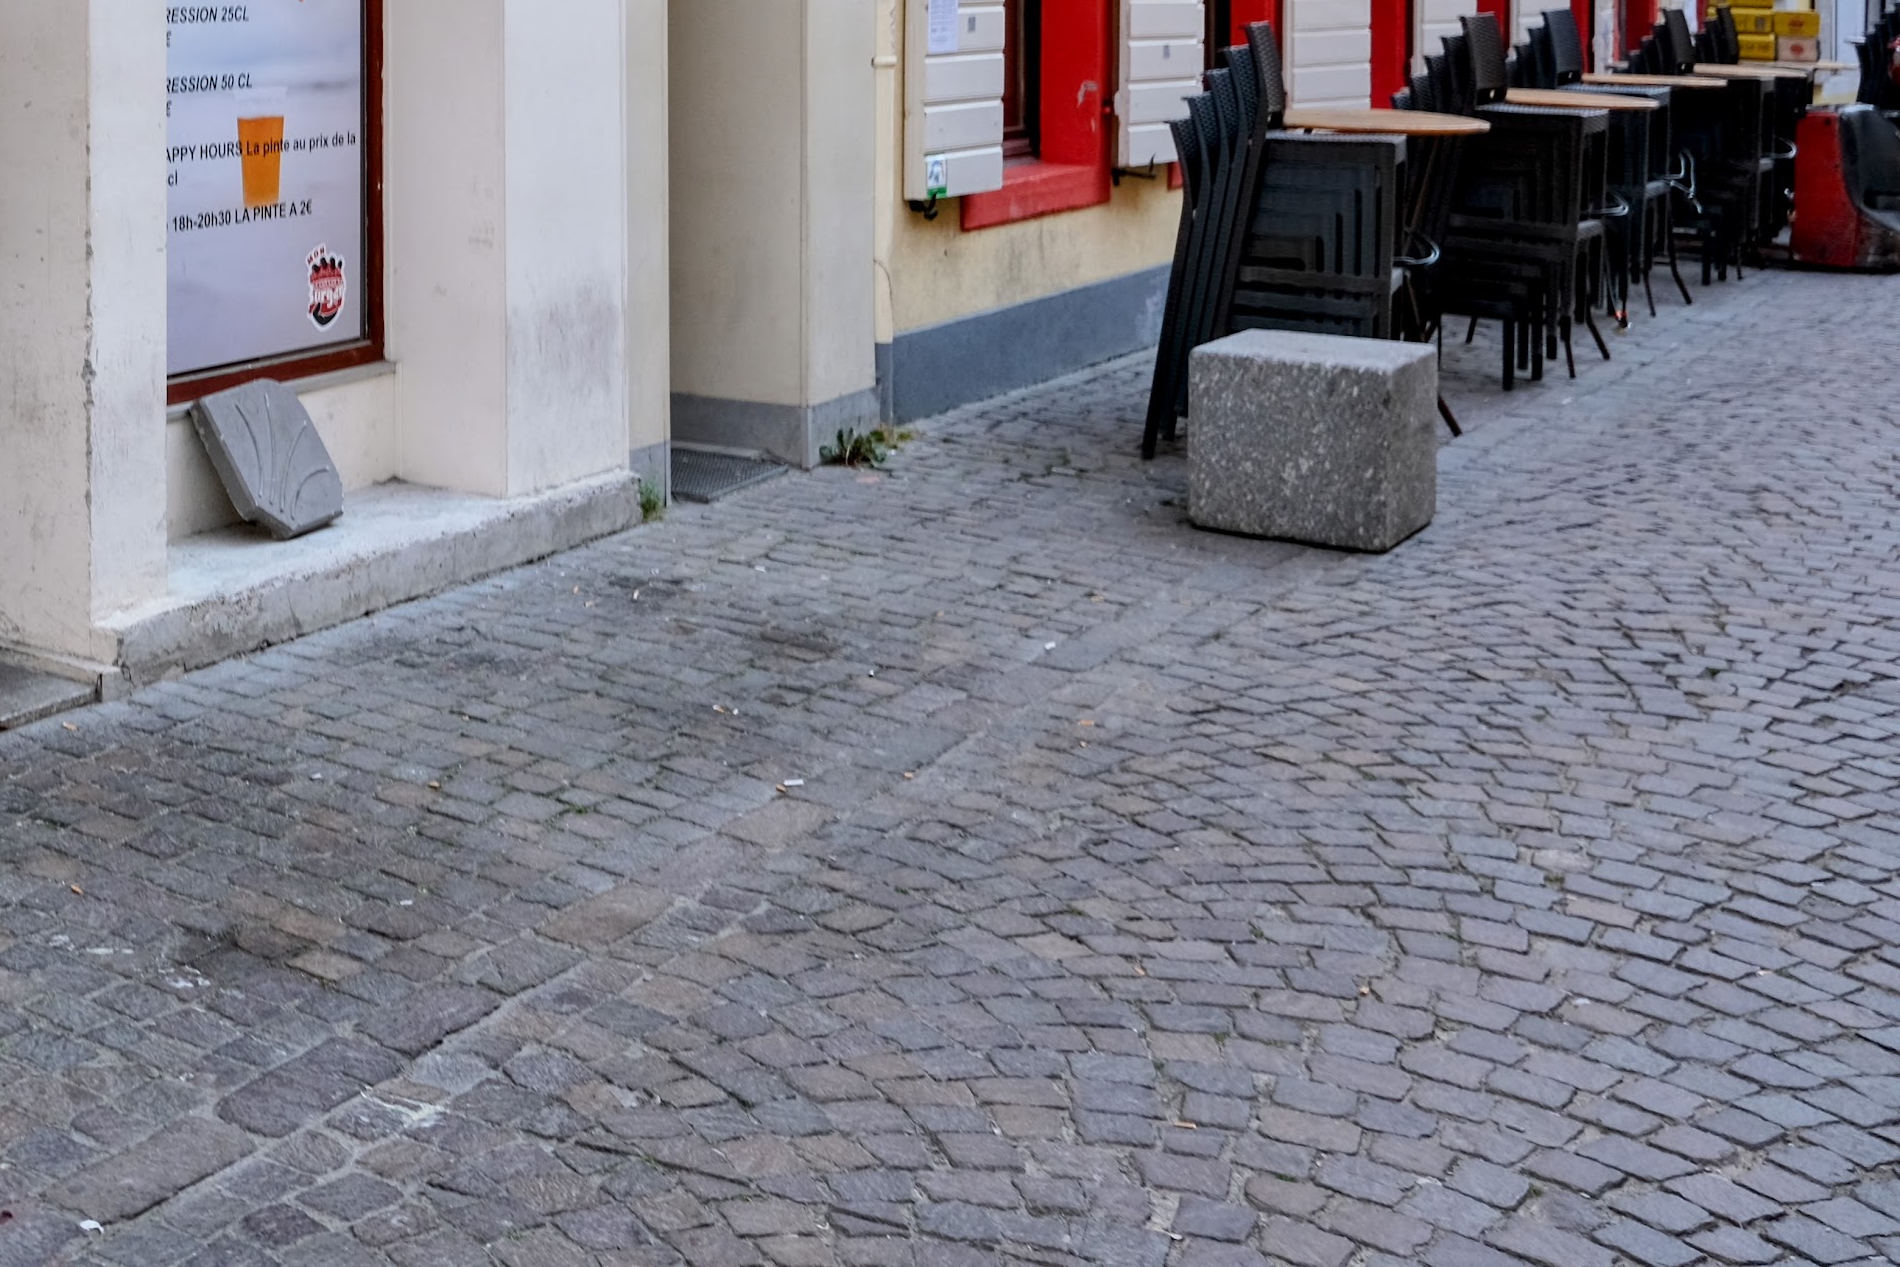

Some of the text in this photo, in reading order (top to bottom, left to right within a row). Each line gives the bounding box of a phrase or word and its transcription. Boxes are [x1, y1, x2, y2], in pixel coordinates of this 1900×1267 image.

[221, 5, 249, 22] 25CL
[221, 75, 234, 90] 50
[238, 72, 252, 88] CL
[200, 141, 242, 160] HOURS
[246, 140, 259, 156] La
[263, 137, 290, 157] pinte
[293, 139, 306, 152] au
[309, 133, 328, 152] prix
[332, 131, 344, 146] de
[347, 131, 356, 145] la
[173, 199, 312, 233] 18h-20h30 LA PINTE A 2€
